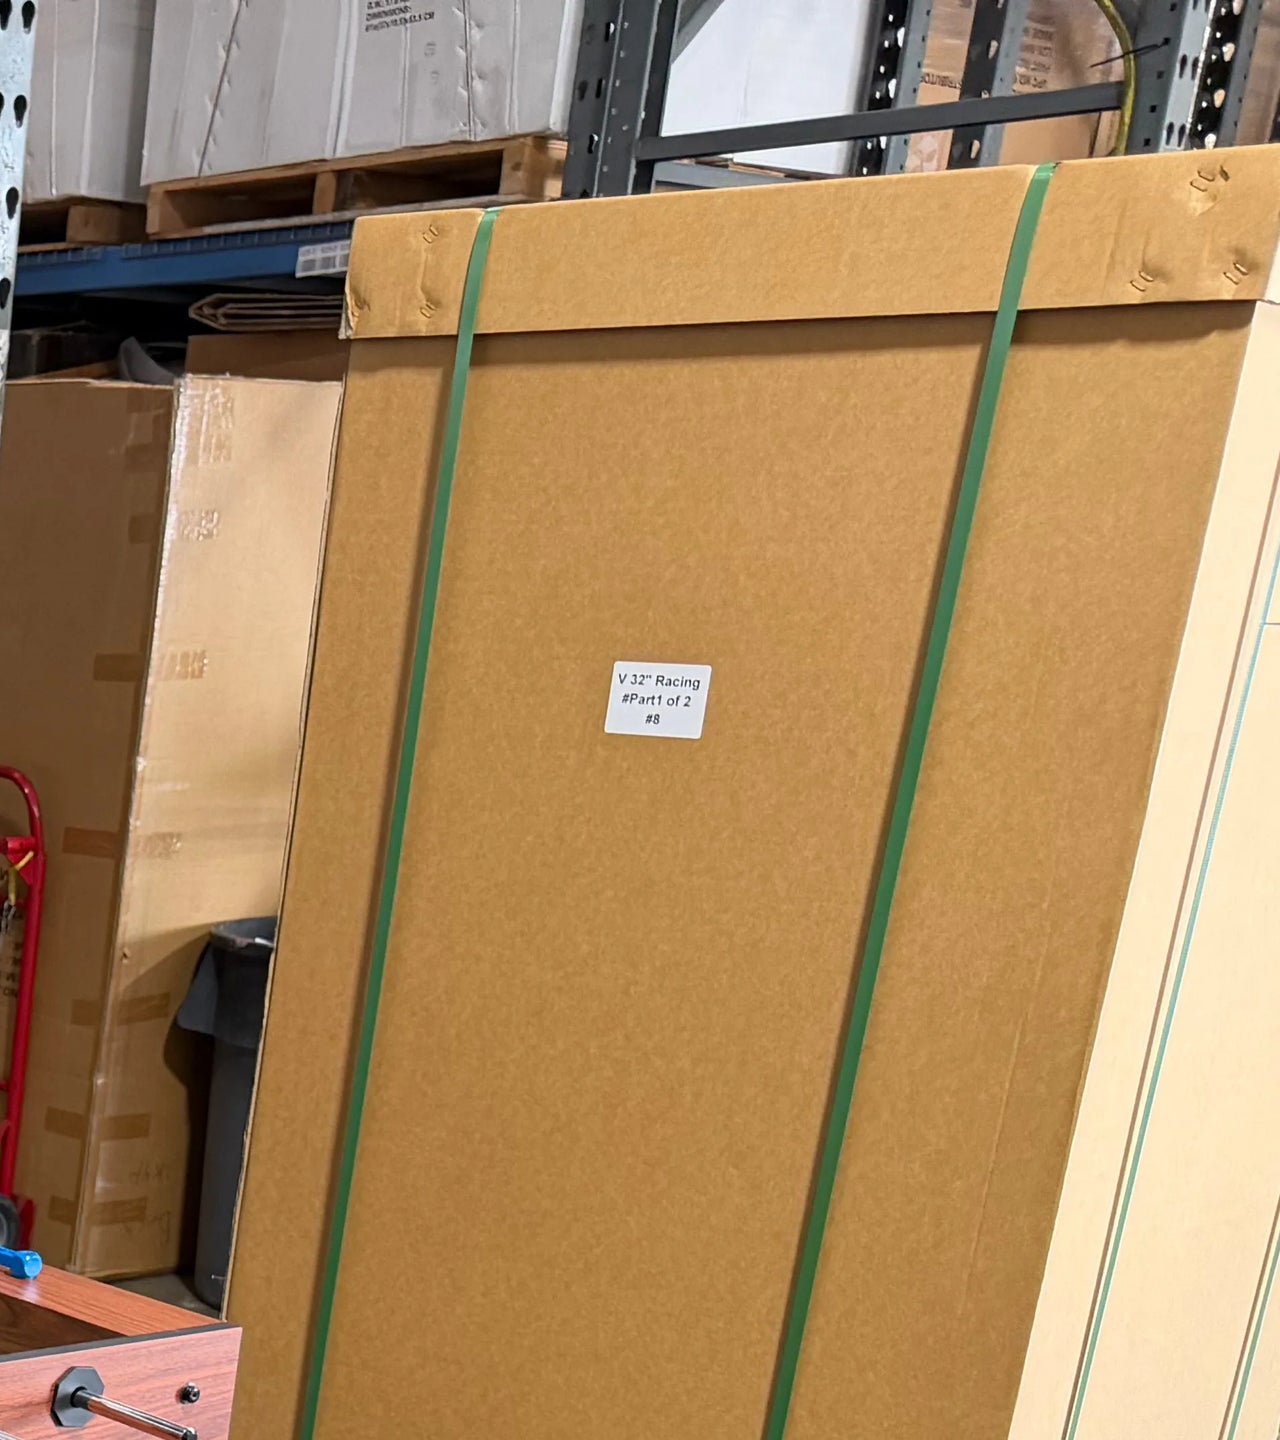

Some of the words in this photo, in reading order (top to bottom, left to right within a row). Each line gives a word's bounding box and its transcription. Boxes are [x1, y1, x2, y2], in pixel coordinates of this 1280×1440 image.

[618, 673, 628, 685] V
[630, 674, 652, 686] 32"
[655, 675, 701, 691] Racing
[621, 693, 663, 706] #Part1
[666, 695, 681, 707] of
[683, 695, 692, 707] 2
[645, 713, 661, 725] #8
